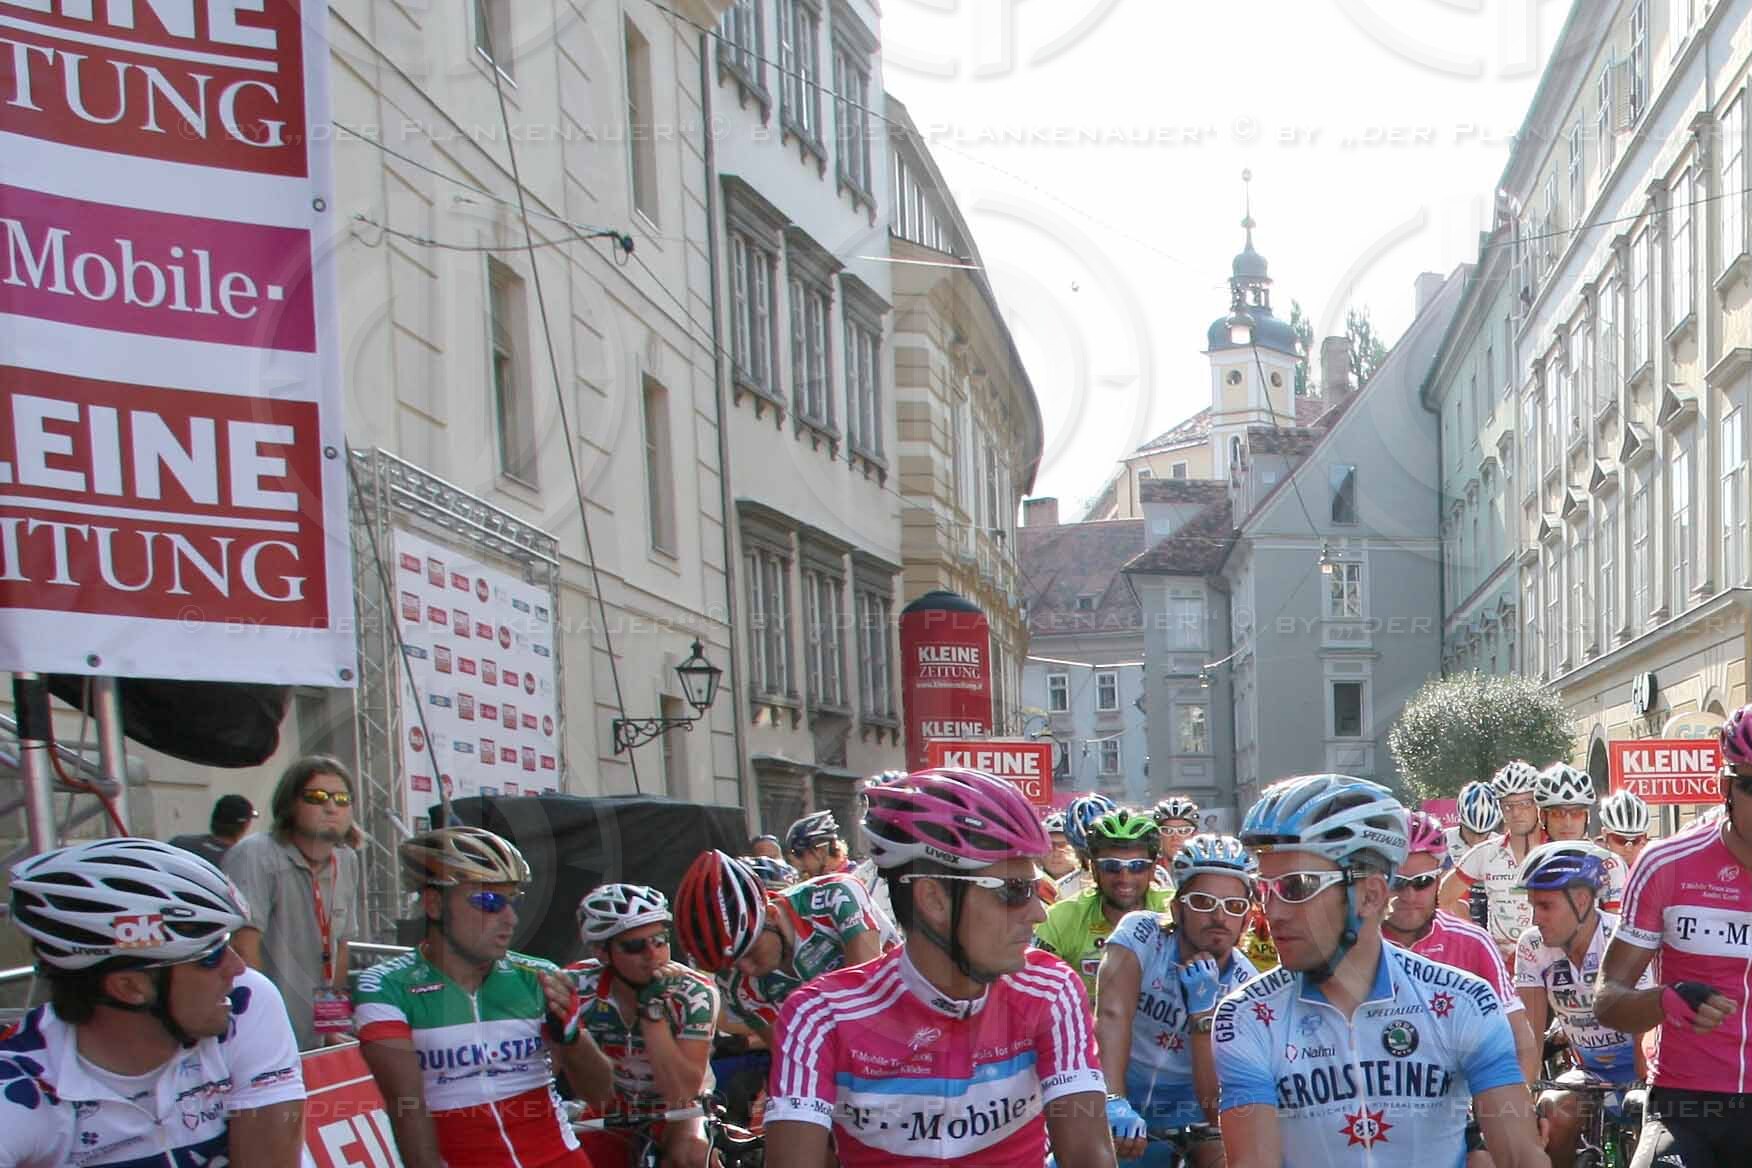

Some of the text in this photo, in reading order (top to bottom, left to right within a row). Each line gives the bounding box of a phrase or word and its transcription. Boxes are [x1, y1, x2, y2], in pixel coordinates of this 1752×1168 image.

[0, 393, 299, 512] EINE
[918, 646, 980, 664] KLEINE
[919, 665, 981, 679] ZEITUNG
[921, 720, 983, 737] KLEINE
[944, 751, 1041, 775] KLEINE
[1622, 750, 1716, 772] KLEINE
[1623, 777, 1718, 796] ZEITUNG
[925, 845, 960, 866] uvex
